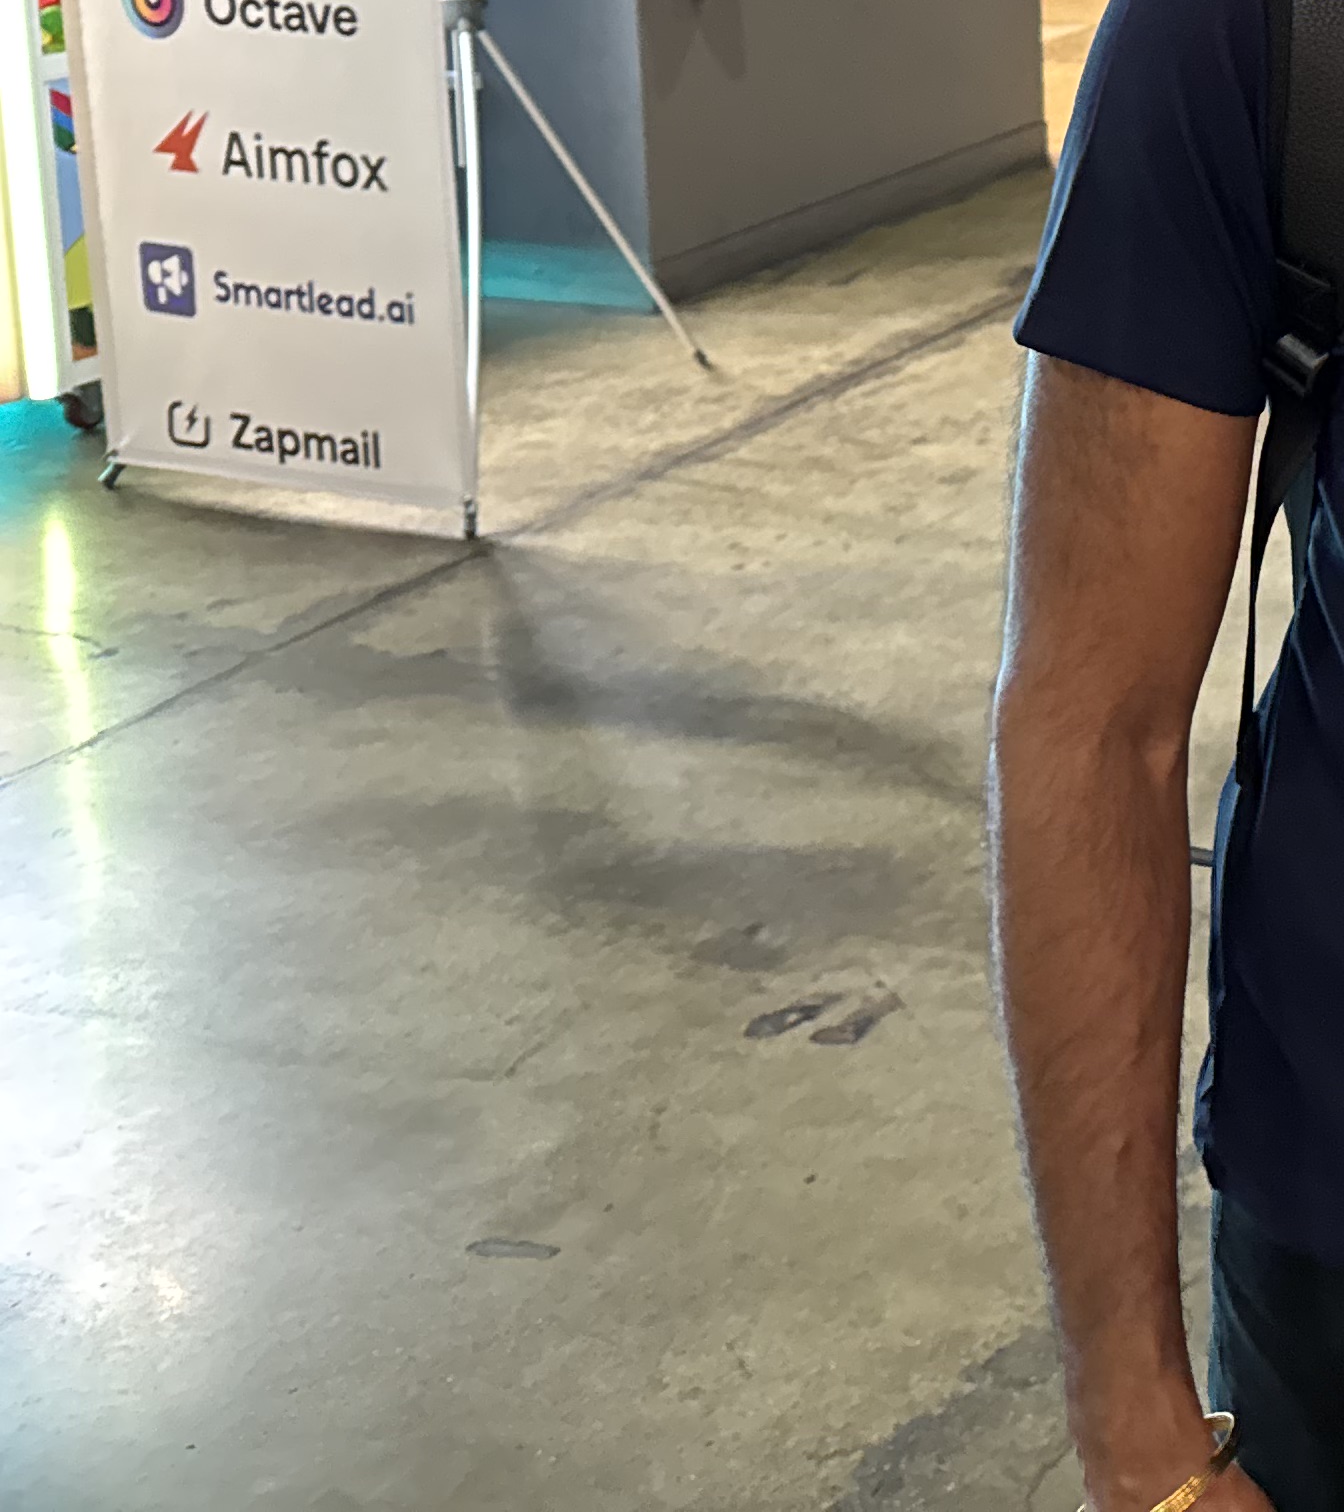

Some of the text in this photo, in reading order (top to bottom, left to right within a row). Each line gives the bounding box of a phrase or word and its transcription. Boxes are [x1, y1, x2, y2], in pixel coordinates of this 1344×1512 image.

[222, 131, 388, 192] Aimfox
[213, 270, 415, 325] Smartlead.ai
[229, 413, 382, 469] Zapmail
